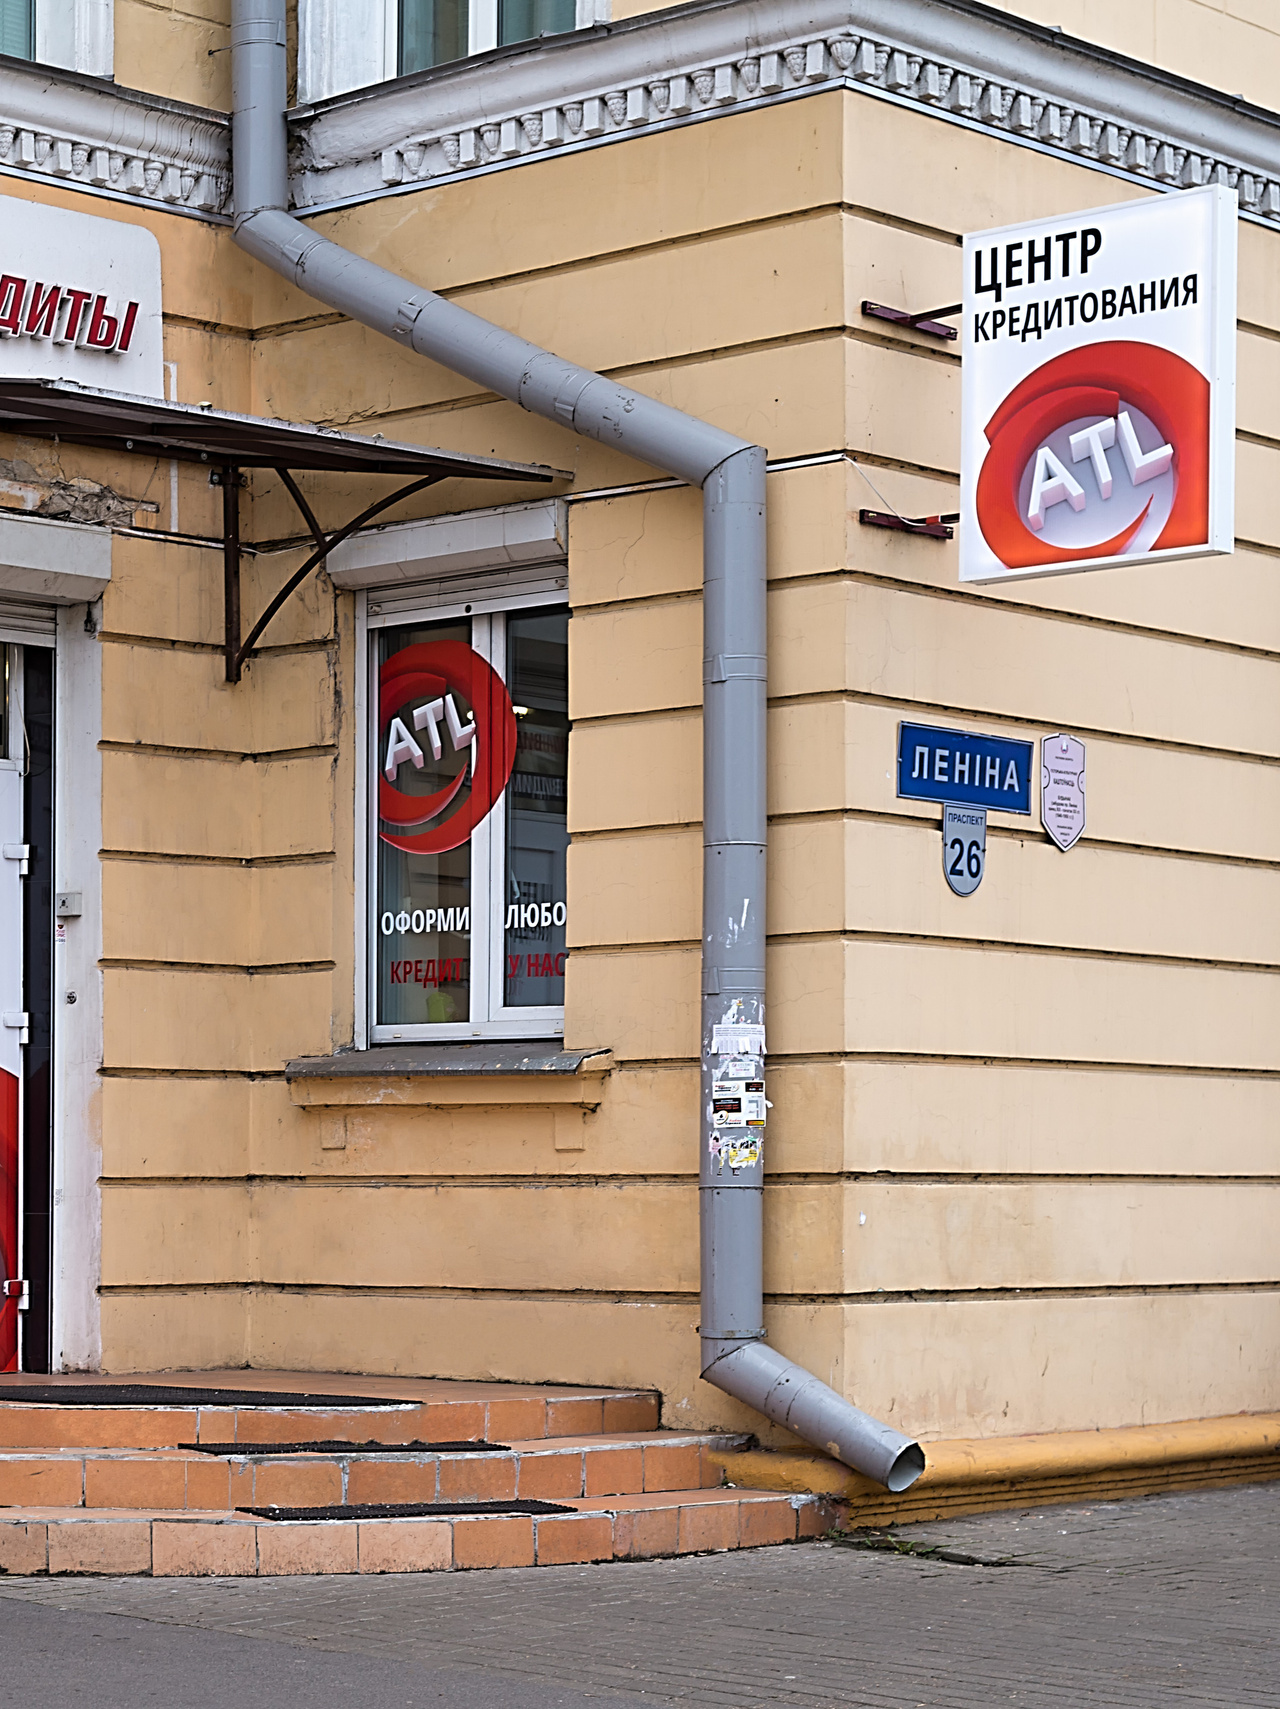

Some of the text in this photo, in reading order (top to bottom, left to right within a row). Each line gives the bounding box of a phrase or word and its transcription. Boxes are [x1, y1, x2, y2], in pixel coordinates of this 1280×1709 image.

[973, 228, 1103, 302] ЦЕНТР
[973, 274, 1199, 343] КРЕДИТОВАНИЯ
[1027, 411, 1174, 531] ATL
[385, 693, 476, 782] ATL
[912, 745, 1020, 793] ЛЕНІНА
[947, 812, 984, 827] ПРАСПЕКТ
[949, 837, 981, 879] 26
[381, 901, 567, 936] ОФОРМИ ЛЮБО
[390, 957, 464, 988] КРЕДИТ
[507, 953, 521, 979] У
